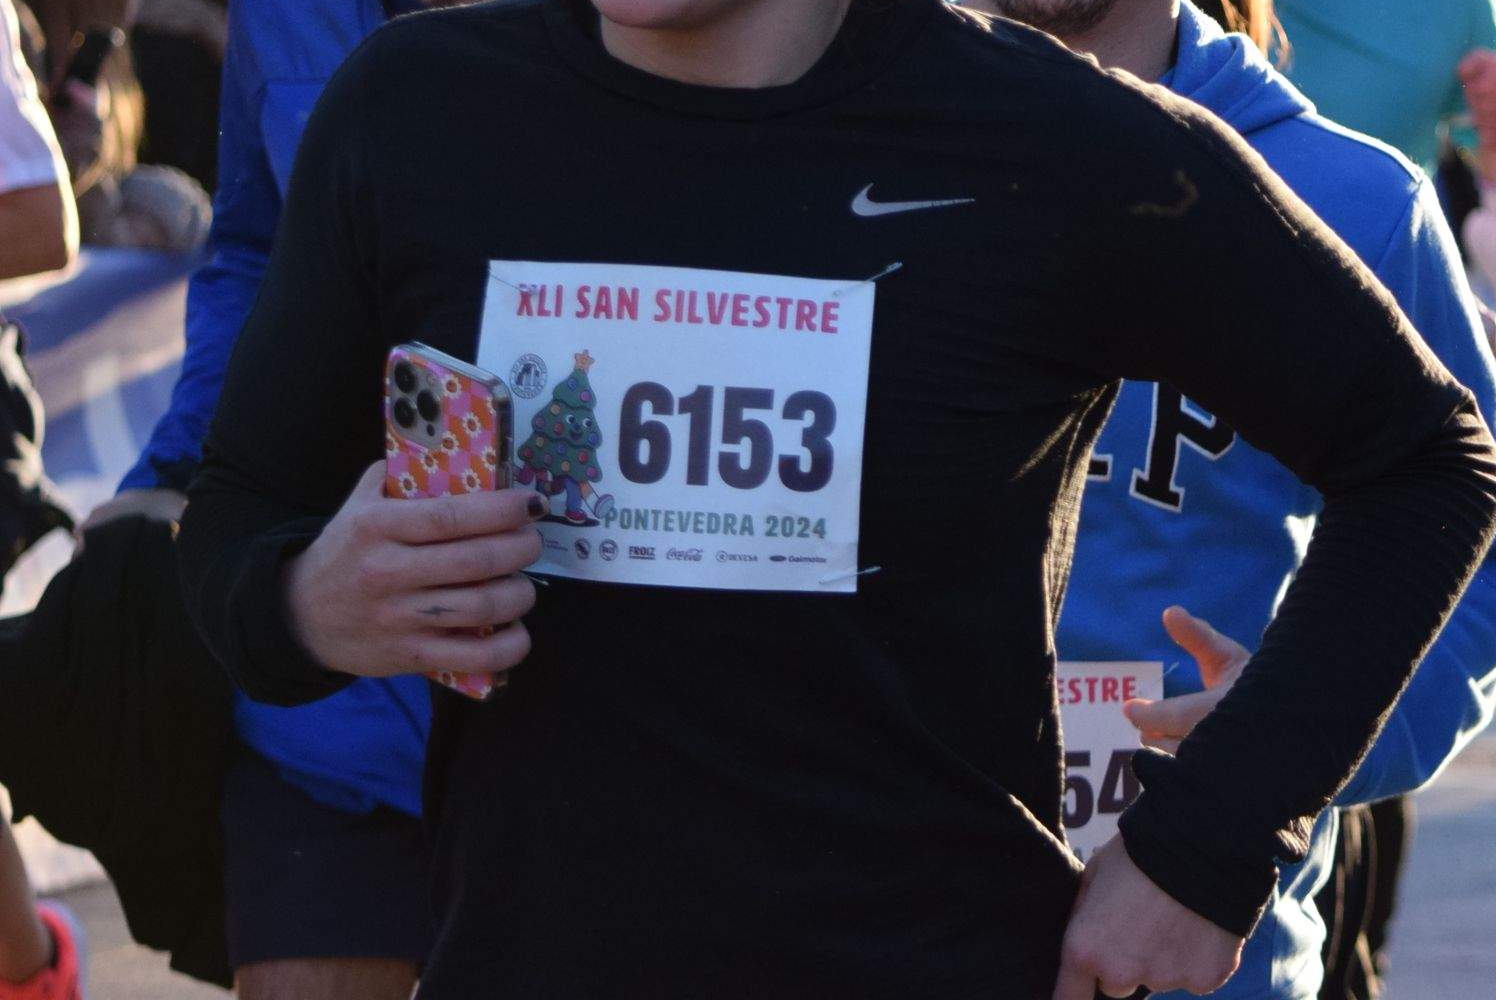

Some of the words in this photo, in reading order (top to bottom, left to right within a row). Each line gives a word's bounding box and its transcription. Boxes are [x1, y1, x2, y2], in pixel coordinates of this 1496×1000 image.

[516, 283, 564, 318] XLI
[575, 285, 640, 321] SAN
[653, 288, 841, 334] SILVESTRE
[618, 381, 837, 492] 6153
[604, 507, 755, 537] PONTEVEDRA
[764, 513, 827, 539] 2024
